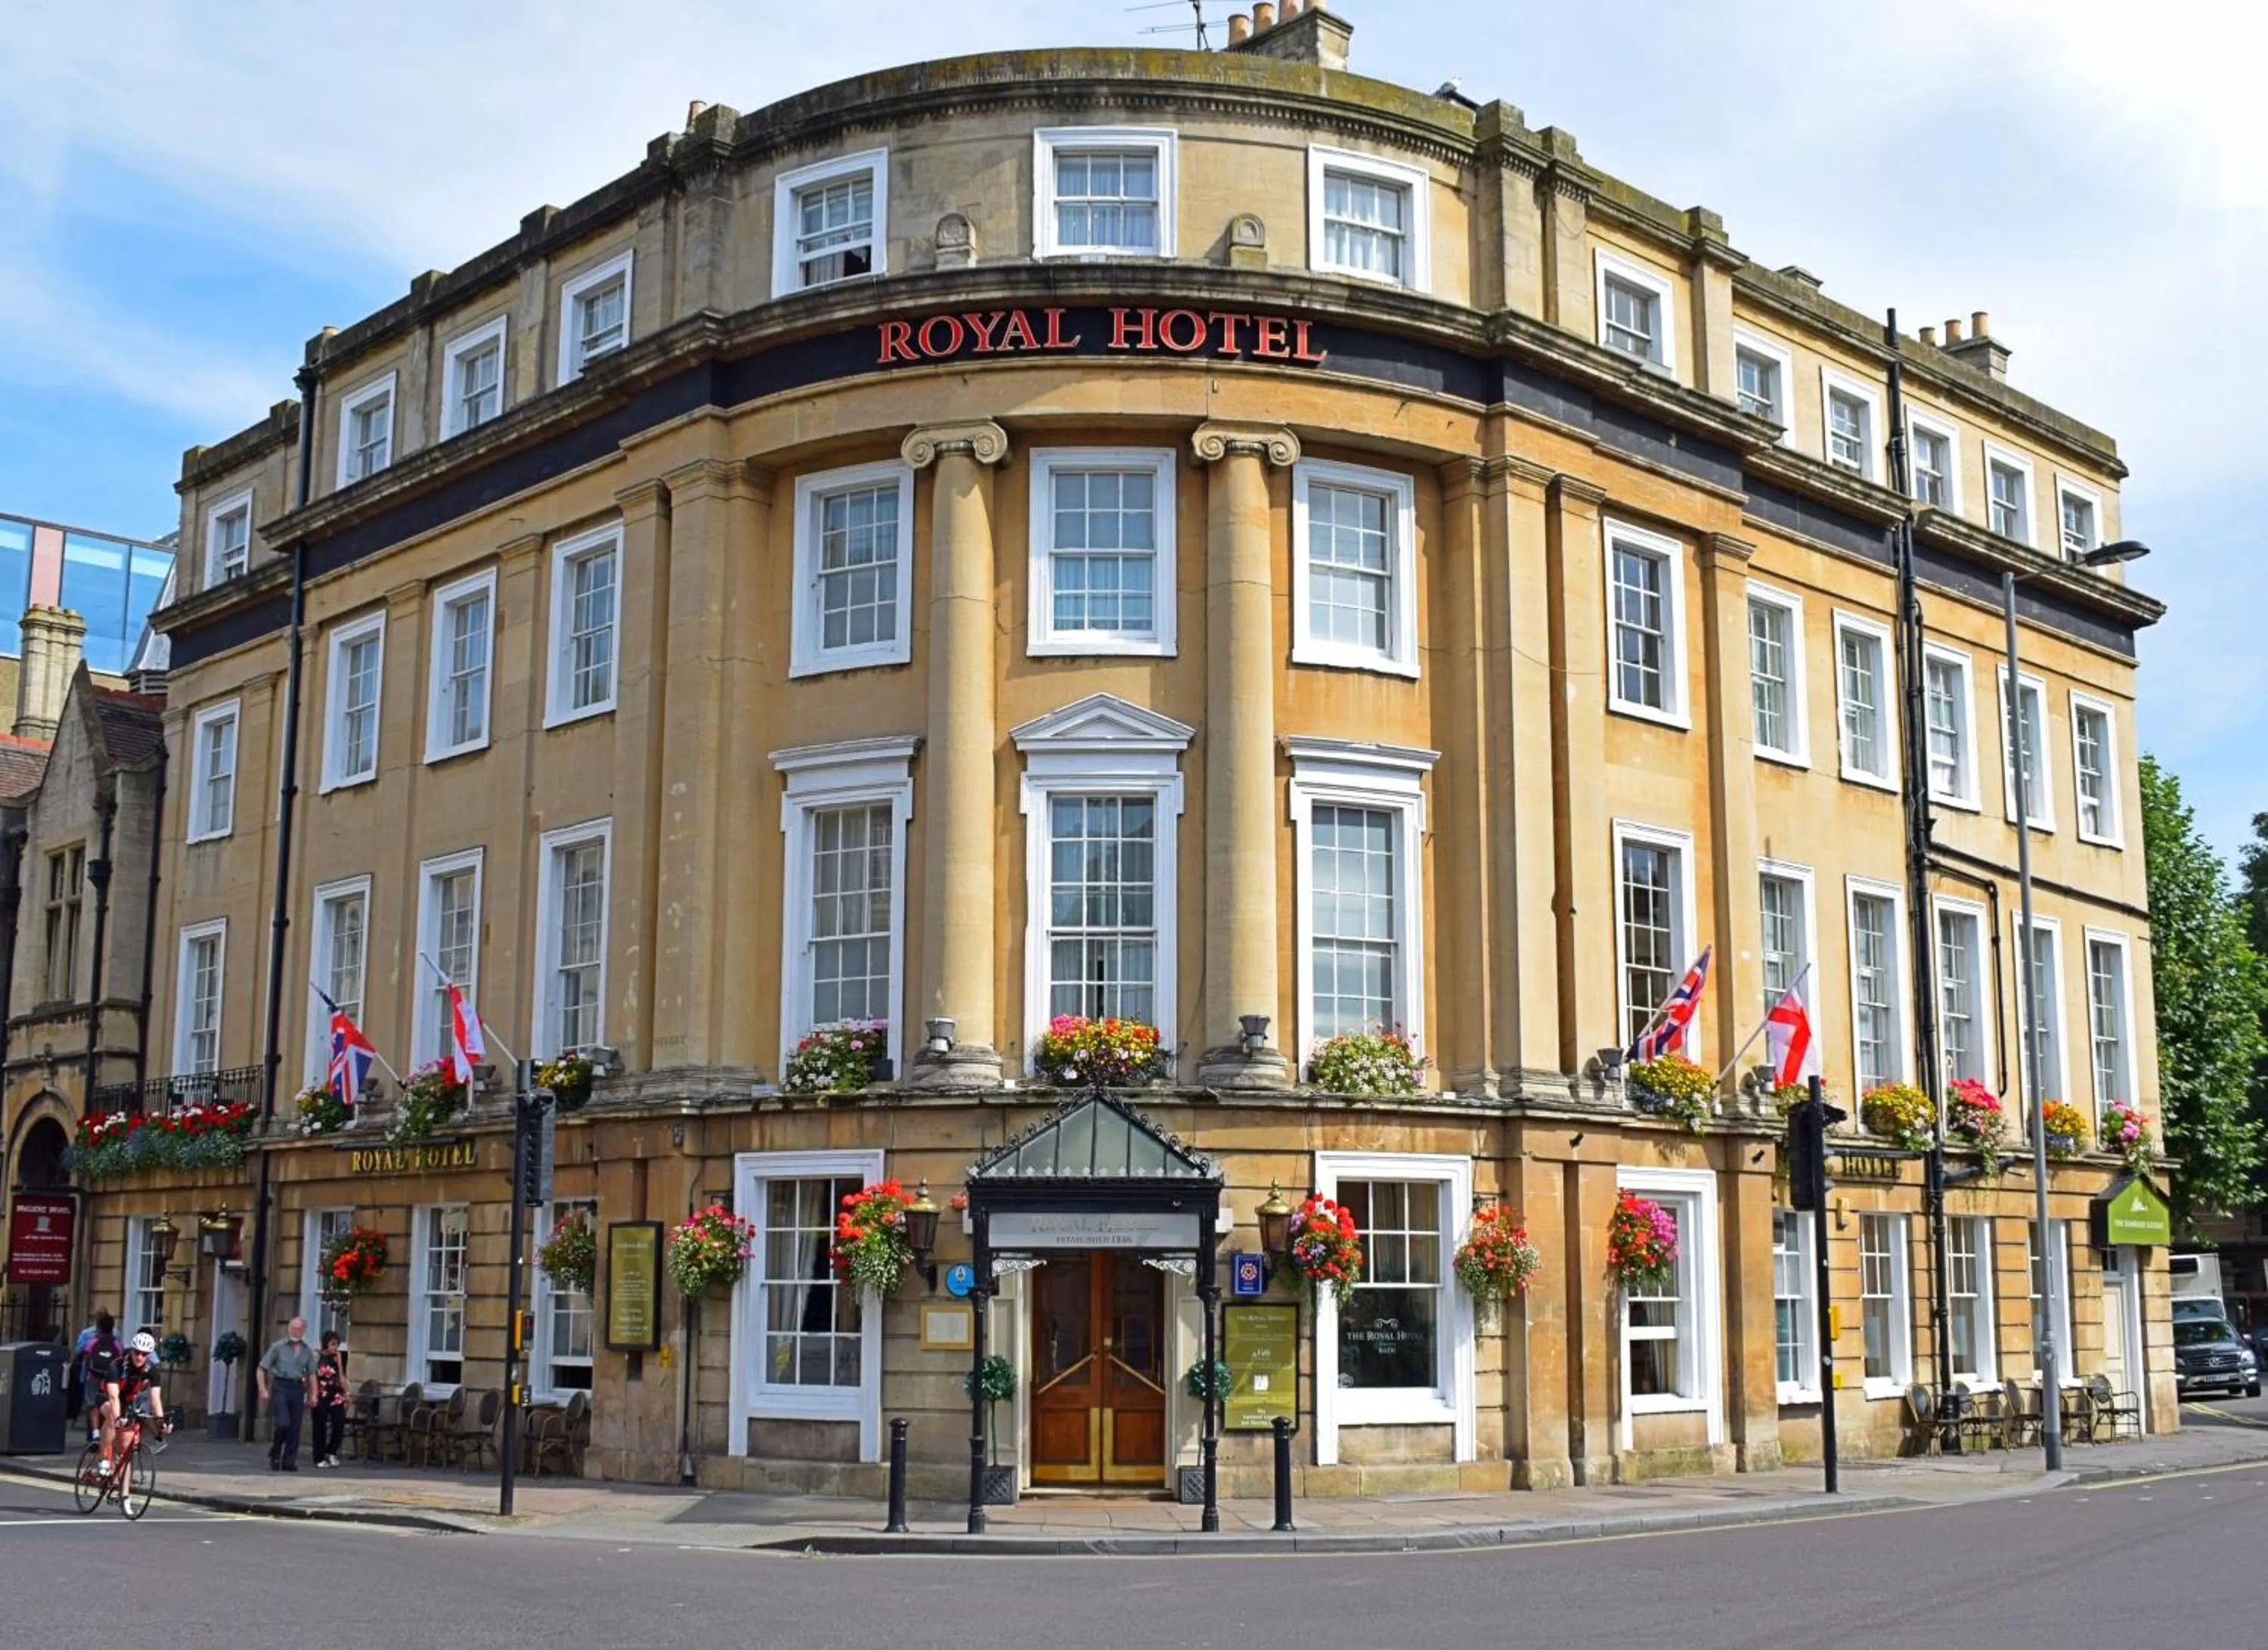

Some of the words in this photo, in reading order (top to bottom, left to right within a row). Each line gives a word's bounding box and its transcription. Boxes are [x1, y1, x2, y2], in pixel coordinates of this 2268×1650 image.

[877, 308, 1081, 363] ROYAL
[1108, 308, 1328, 361] HOTEL
[352, 1148, 405, 1171] ROYAL
[1347, 1332, 1365, 1341] THE
[1367, 1331, 1395, 1341] ROYAL
